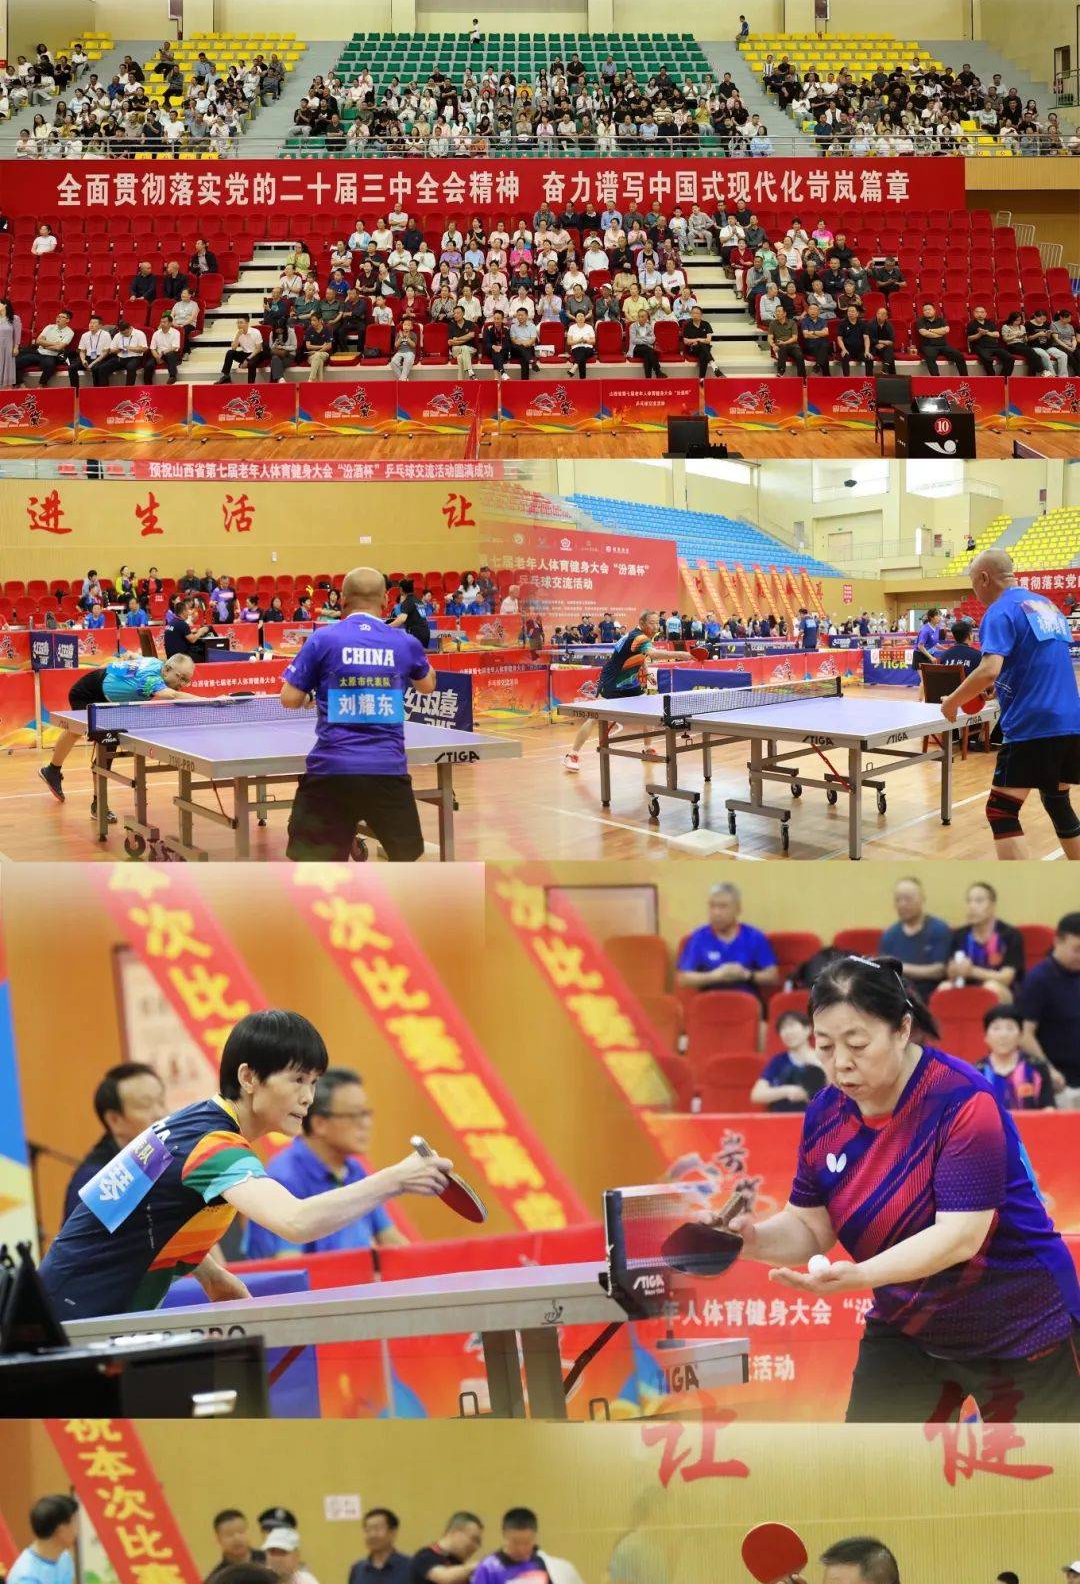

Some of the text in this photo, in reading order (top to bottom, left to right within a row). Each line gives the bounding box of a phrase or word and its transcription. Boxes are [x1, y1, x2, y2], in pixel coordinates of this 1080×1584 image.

[56, 168, 911, 207] 全面贯彻落实党的二十届三中全会精神 奋力谱写中国式现代化岢岚篇章
[935, 419, 950, 433] 10
[341, 646, 395, 667] CHINA
[191, 676, 287, 689] 山西省第七届老年人体育健身大会“
[338, 676, 391, 688] 太原市代表队
[338, 694, 394, 717] 刘耀东
[404, 688, 459, 720] 红双喜
[802, 734, 834, 747] STIGA
[886, 731, 909, 745] STIGA
[434, 750, 481, 763] STIGA
[633, 1273, 666, 1289] STIGA
[748, 1354, 796, 1382] 活动
